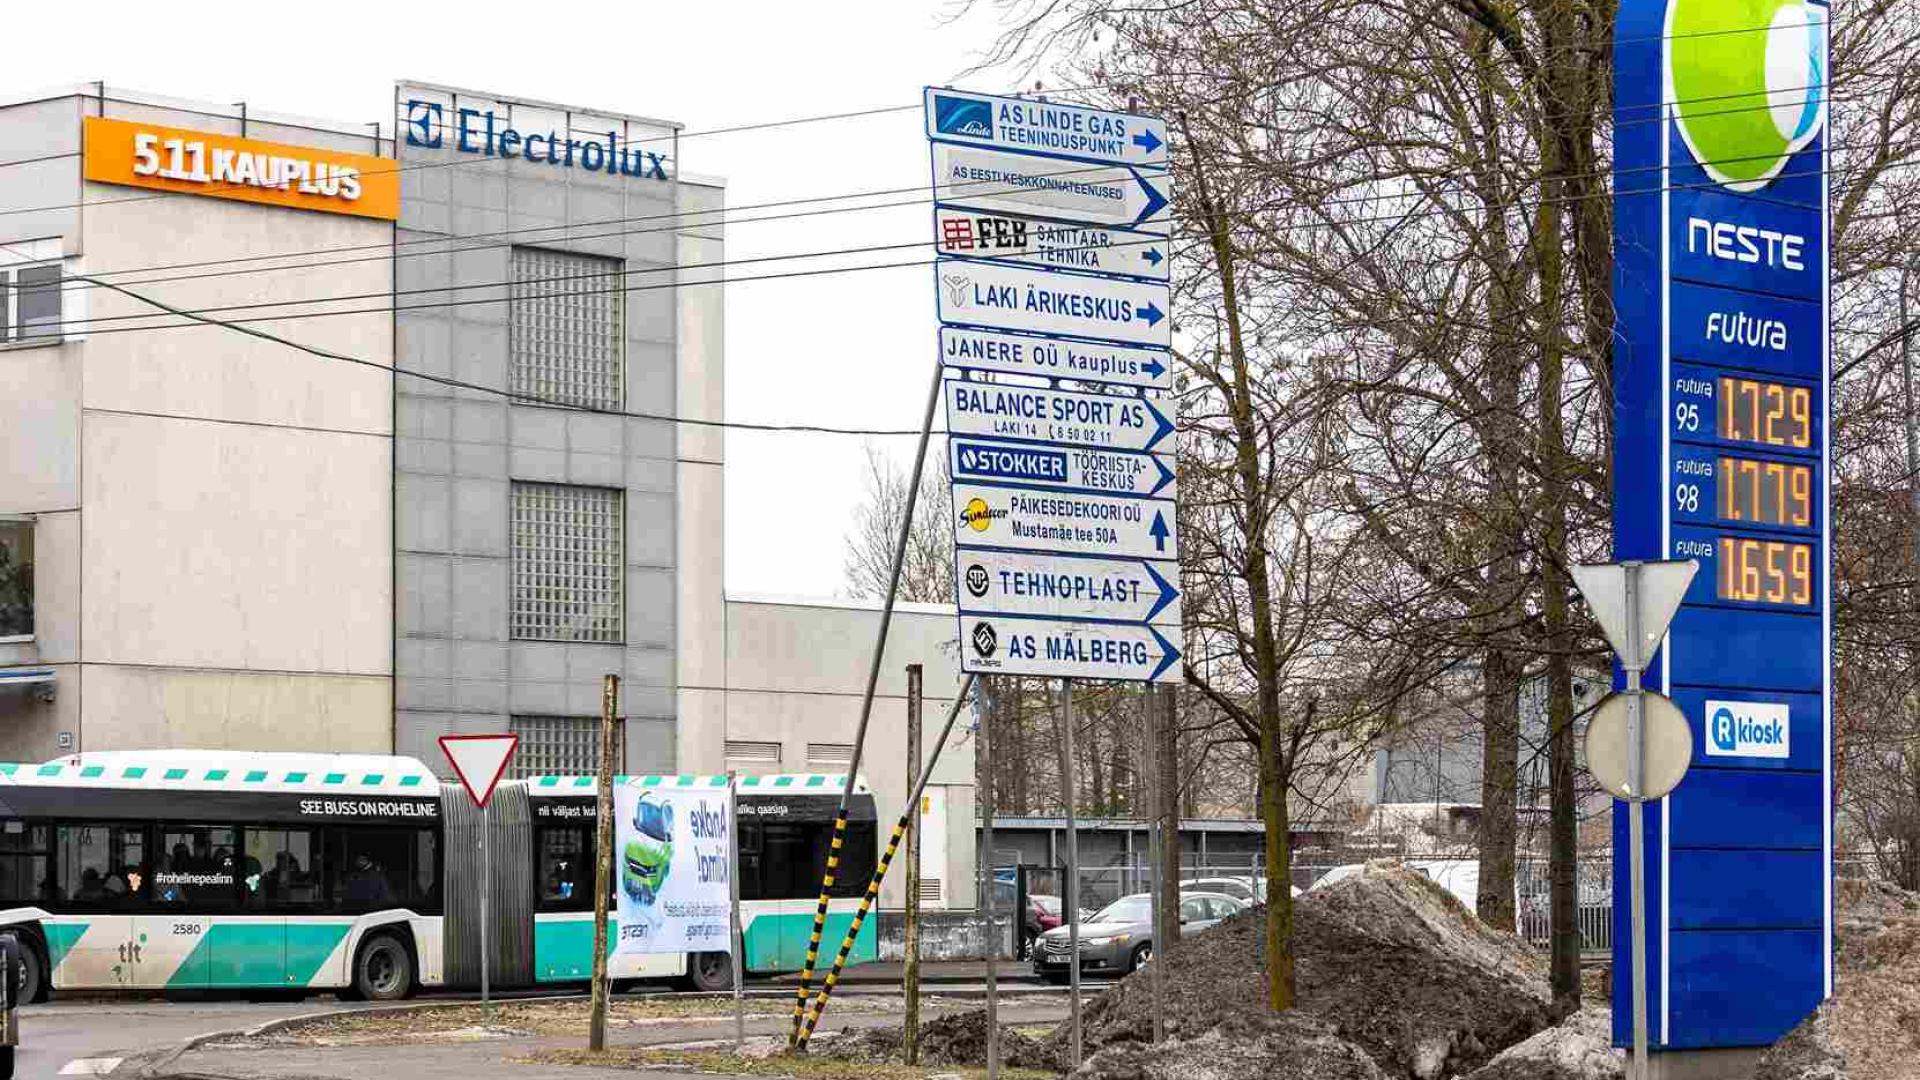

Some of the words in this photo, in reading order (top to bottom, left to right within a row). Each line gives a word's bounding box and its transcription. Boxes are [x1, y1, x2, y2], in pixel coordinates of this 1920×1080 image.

[999, 103, 1024, 123] AS
[1029, 107, 1082, 130] LINDE
[1088, 115, 1126, 137] GAS
[459, 107, 669, 180] Electrolux
[1000, 126, 1126, 156] TEENINDUSPUNKT
[133, 133, 212, 183] 5.11
[212, 147, 361, 200] KAUPLUS
[952, 165, 969, 179] AS
[970, 168, 1000, 182] EESTI
[1003, 174, 1123, 200] KESKKONNATEENUSED
[977, 217, 1027, 249] FEB
[1688, 216, 1805, 271] NESTE
[1038, 244, 1100, 268] TEHNIKA
[974, 282, 1018, 308] LAKI
[1025, 284, 1132, 322] ÄRIKESKUS
[1706, 311, 1787, 351] Futura
[947, 337, 1023, 363] JANERE
[1033, 343, 1058, 367] OÜ
[1068, 349, 1138, 377] kauplus
[956, 388, 1046, 419] BALANCE
[1052, 397, 1114, 426] SPORT
[1119, 404, 1144, 428] AS
[1676, 402, 1700, 431] 95
[995, 422, 1020, 436] LAKI
[1024, 424, 1036, 437] 14
[1066, 429, 1080, 440] 50
[1084, 430, 1096, 442] 02
[1101, 431, 1111, 443] 11
[978, 452, 1064, 477] STOKKER
[1072, 449, 1146, 474] TÖÖRIISTA-
[1081, 471, 1135, 490] KESKUS
[1011, 496, 1122, 522] PÄIKESEDEKOORI
[1124, 502, 1141, 522] OÜ
[1676, 484, 1699, 512] 98
[1012, 520, 1072, 541] Mustamäe
[1075, 524, 1092, 541] tee
[1095, 527, 1118, 544] 50A
[999, 571, 1140, 603] TEHNOPLAST
[1009, 635, 1036, 659] AS
[1047, 633, 1147, 665] MÄLBERG
[1738, 716, 1783, 744] kiosk
[300, 801, 323, 815] SEE
[325, 801, 358, 815] BUSS
[359, 801, 377, 815] ON
[378, 802, 437, 816] ROHELINE
[156, 872, 233, 886] #rohelinepealinn
[172, 923, 201, 934] 2580
